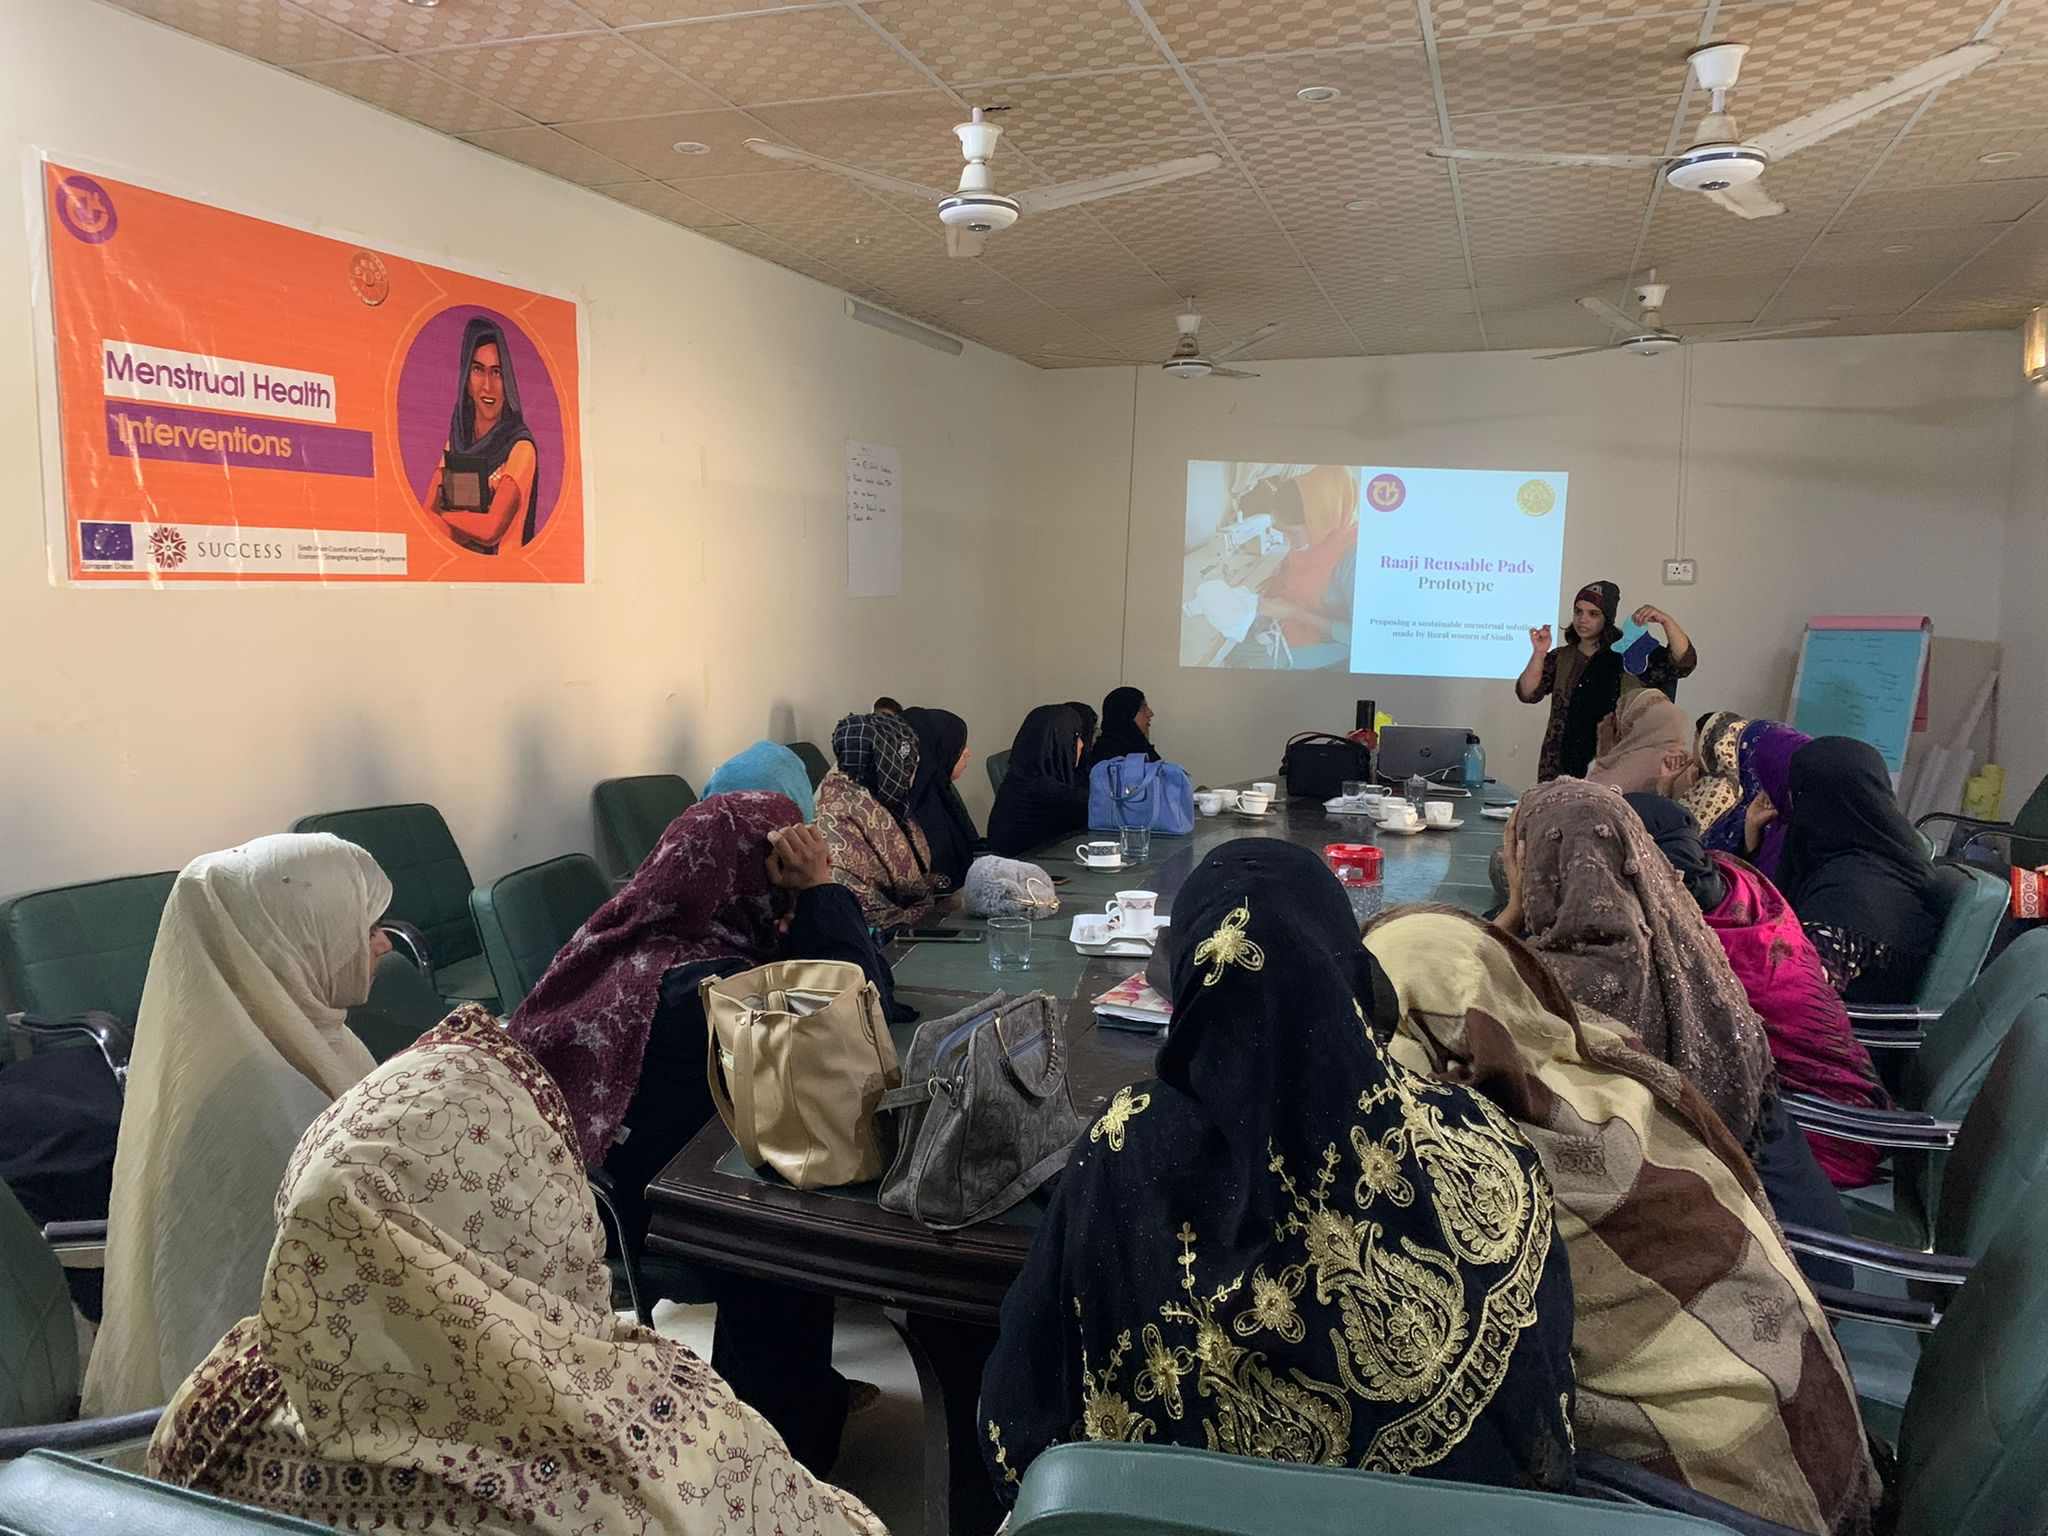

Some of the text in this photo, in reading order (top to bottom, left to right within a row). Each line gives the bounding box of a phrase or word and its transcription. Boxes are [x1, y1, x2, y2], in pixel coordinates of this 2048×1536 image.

[106, 350, 331, 409] Menstrual Health
[117, 412, 292, 458] Interventions
[198, 541, 282, 559] SUCCESS
[1380, 555, 1535, 574] Raaji Reusable Pads
[1418, 576, 1495, 594] Prototype
